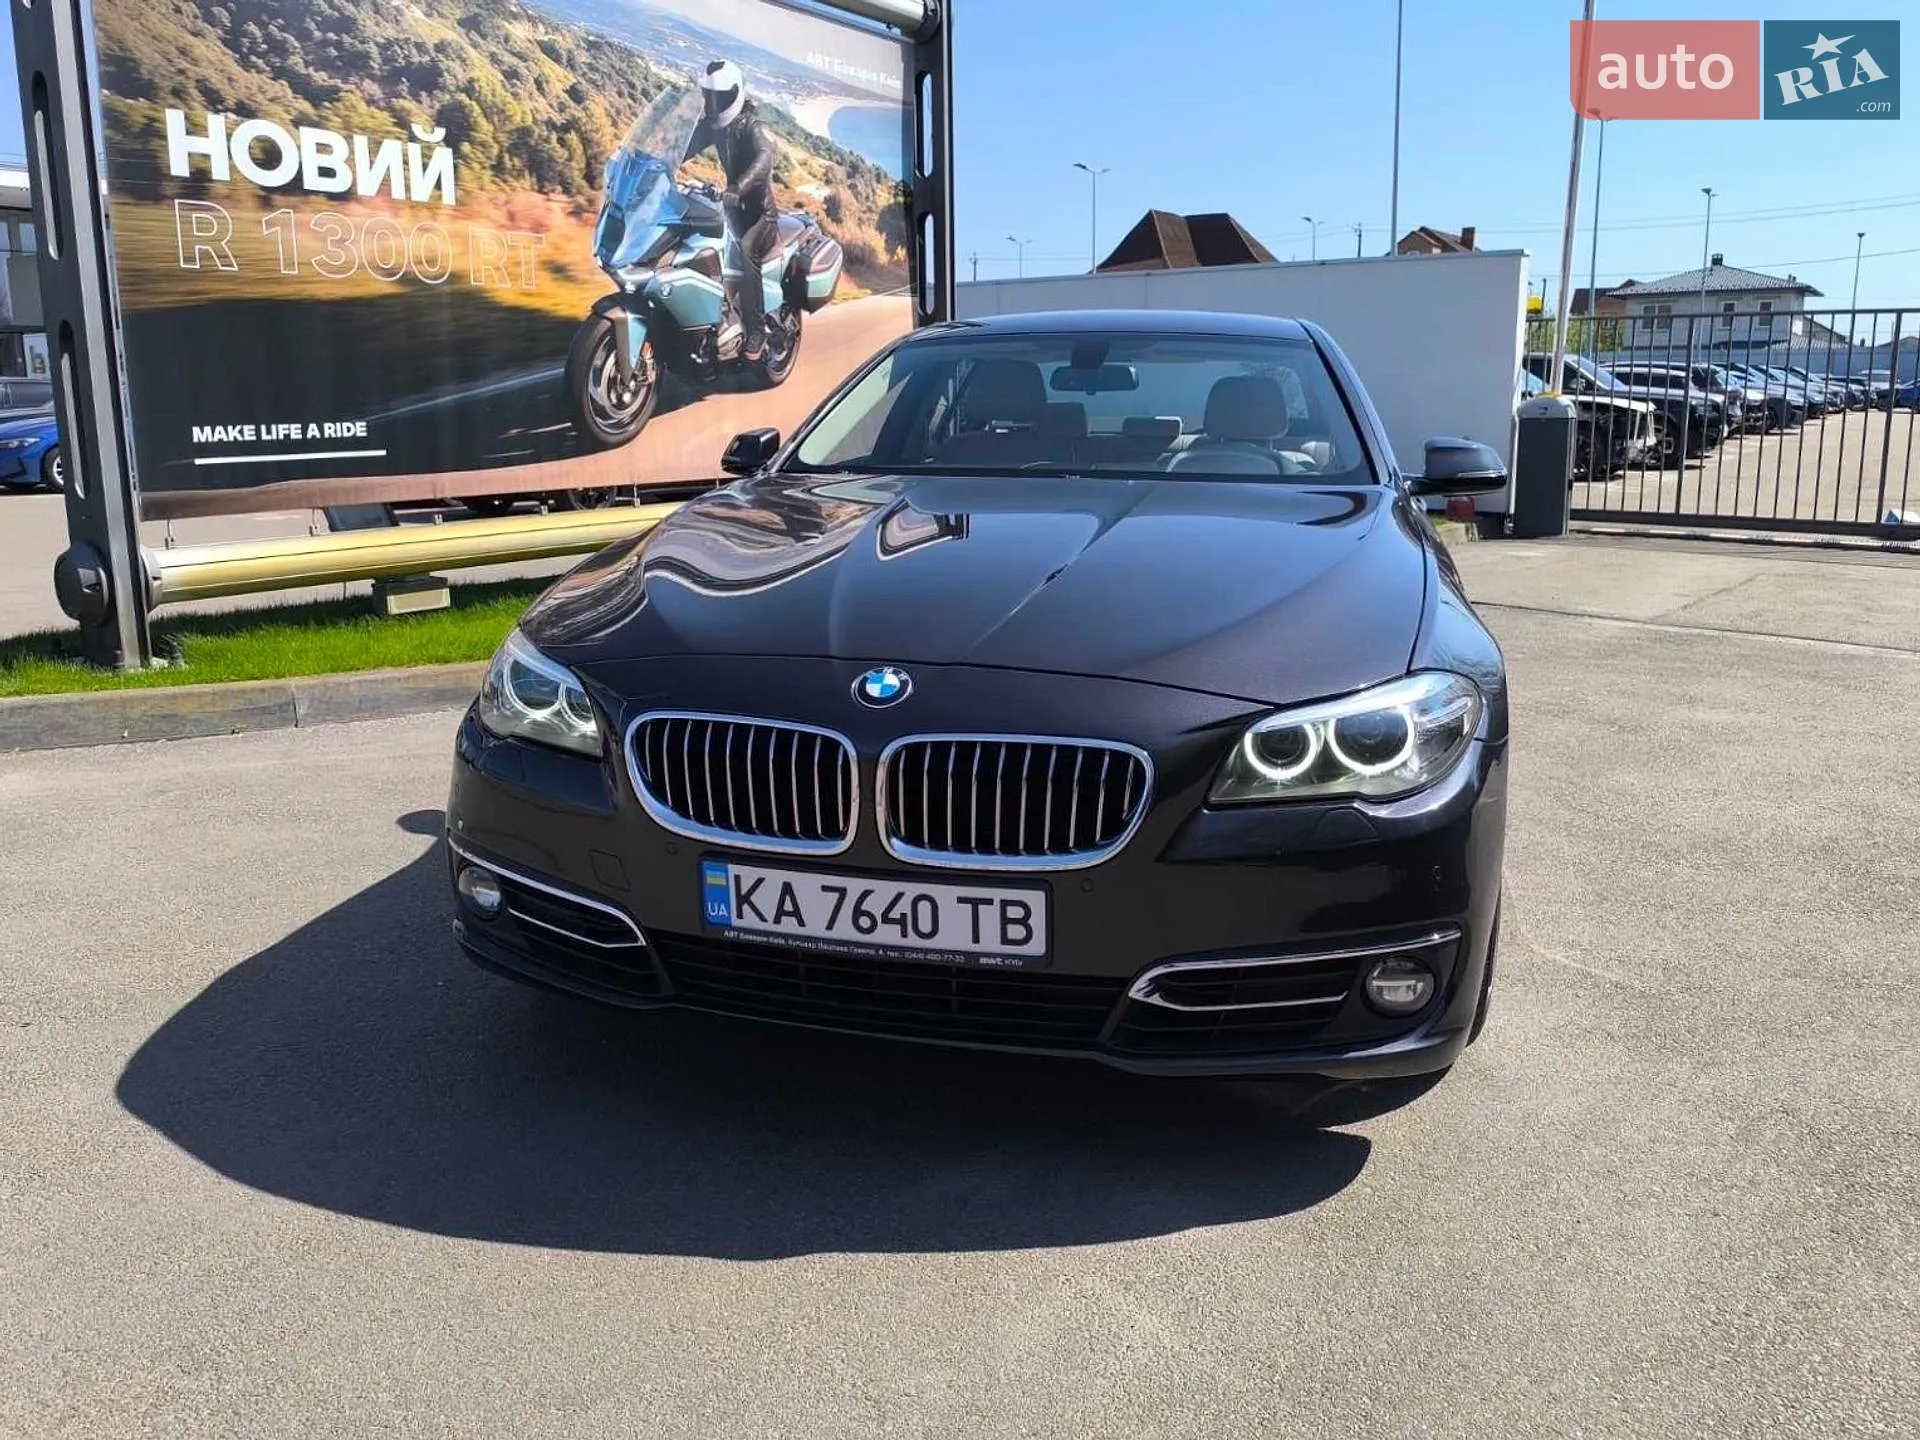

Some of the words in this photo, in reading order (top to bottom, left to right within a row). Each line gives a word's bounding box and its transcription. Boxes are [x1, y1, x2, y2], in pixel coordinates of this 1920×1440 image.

[165, 108, 456, 206] НОВИЙ
[174, 199, 239, 272] R
[262, 208, 453, 285] 1300
[467, 224, 546, 290] RT
[192, 424, 257, 443] MAKE
[260, 423, 303, 441] LIFE
[306, 422, 321, 440] A
[323, 421, 368, 439] RIDE
[708, 901, 729, 917] UA
[733, 873, 807, 929] KA
[820, 884, 940, 941] 7640
[956, 895, 1034, 948] TB
